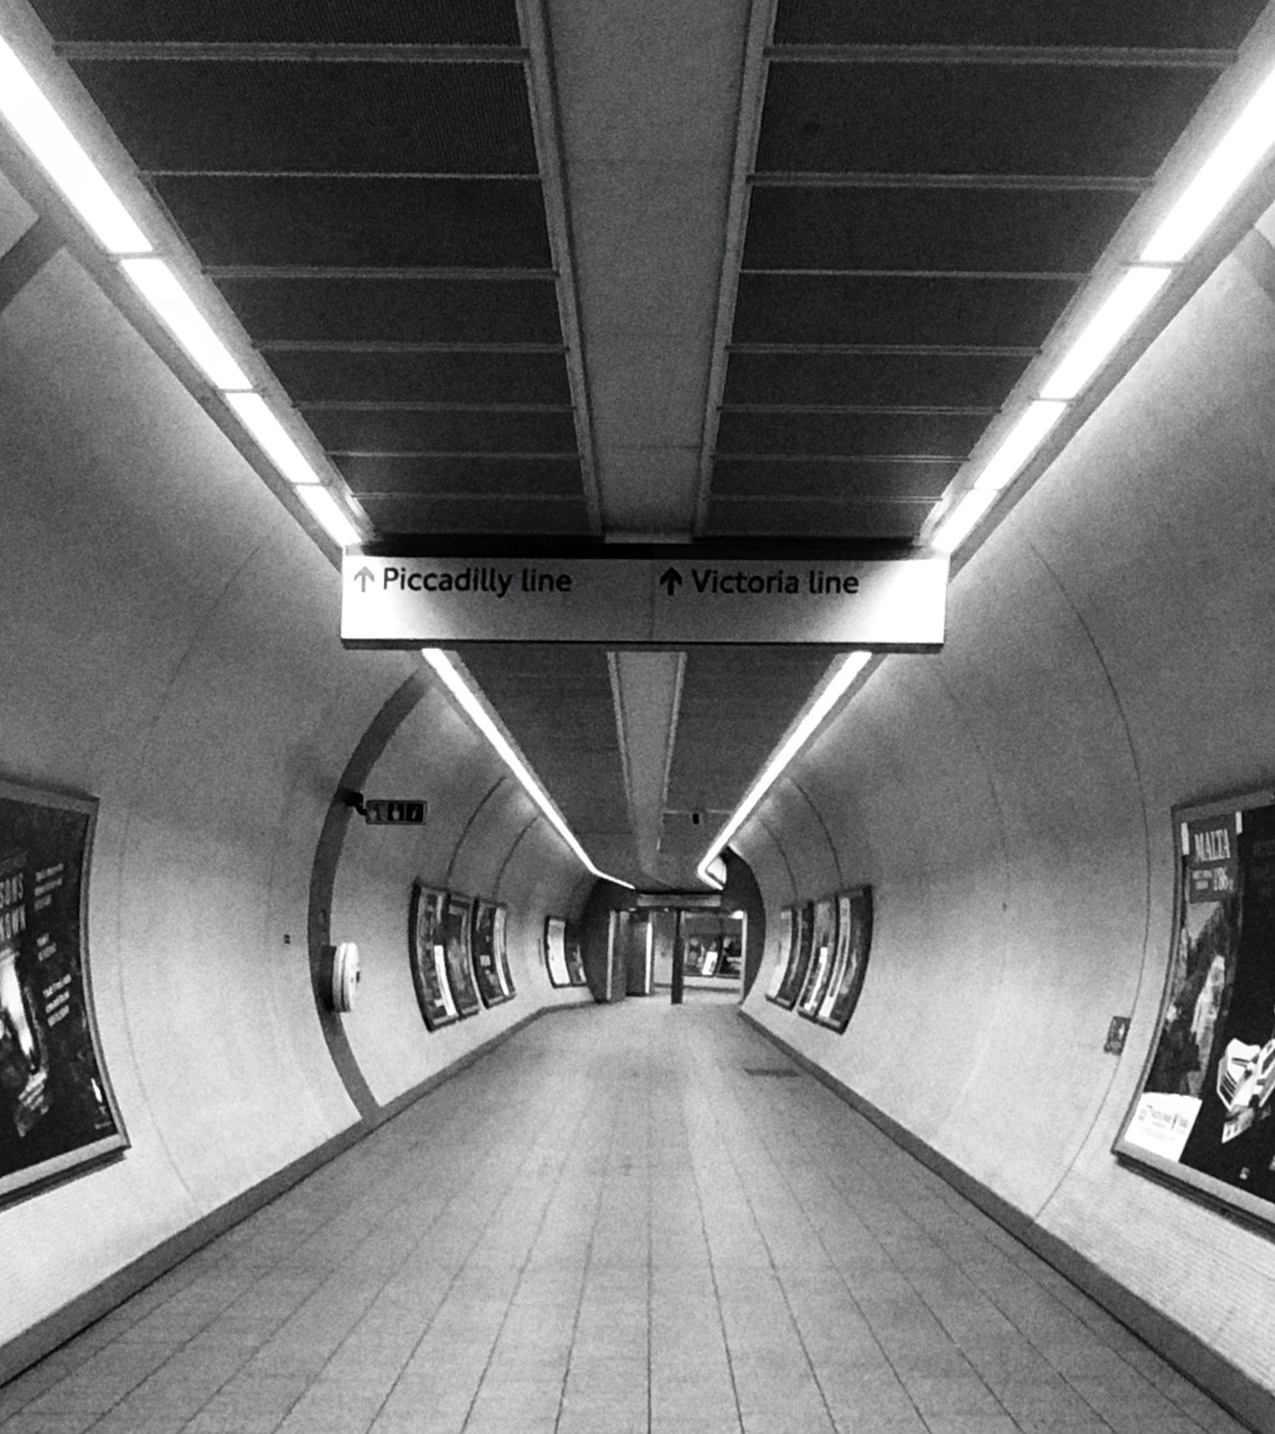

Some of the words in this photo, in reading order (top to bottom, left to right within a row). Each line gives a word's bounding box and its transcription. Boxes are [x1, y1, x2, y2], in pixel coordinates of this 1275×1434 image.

[383, 567, 513, 599] Piccadilly
[521, 568, 573, 593] line
[692, 569, 800, 595] Victoria
[807, 569, 860, 594] line
